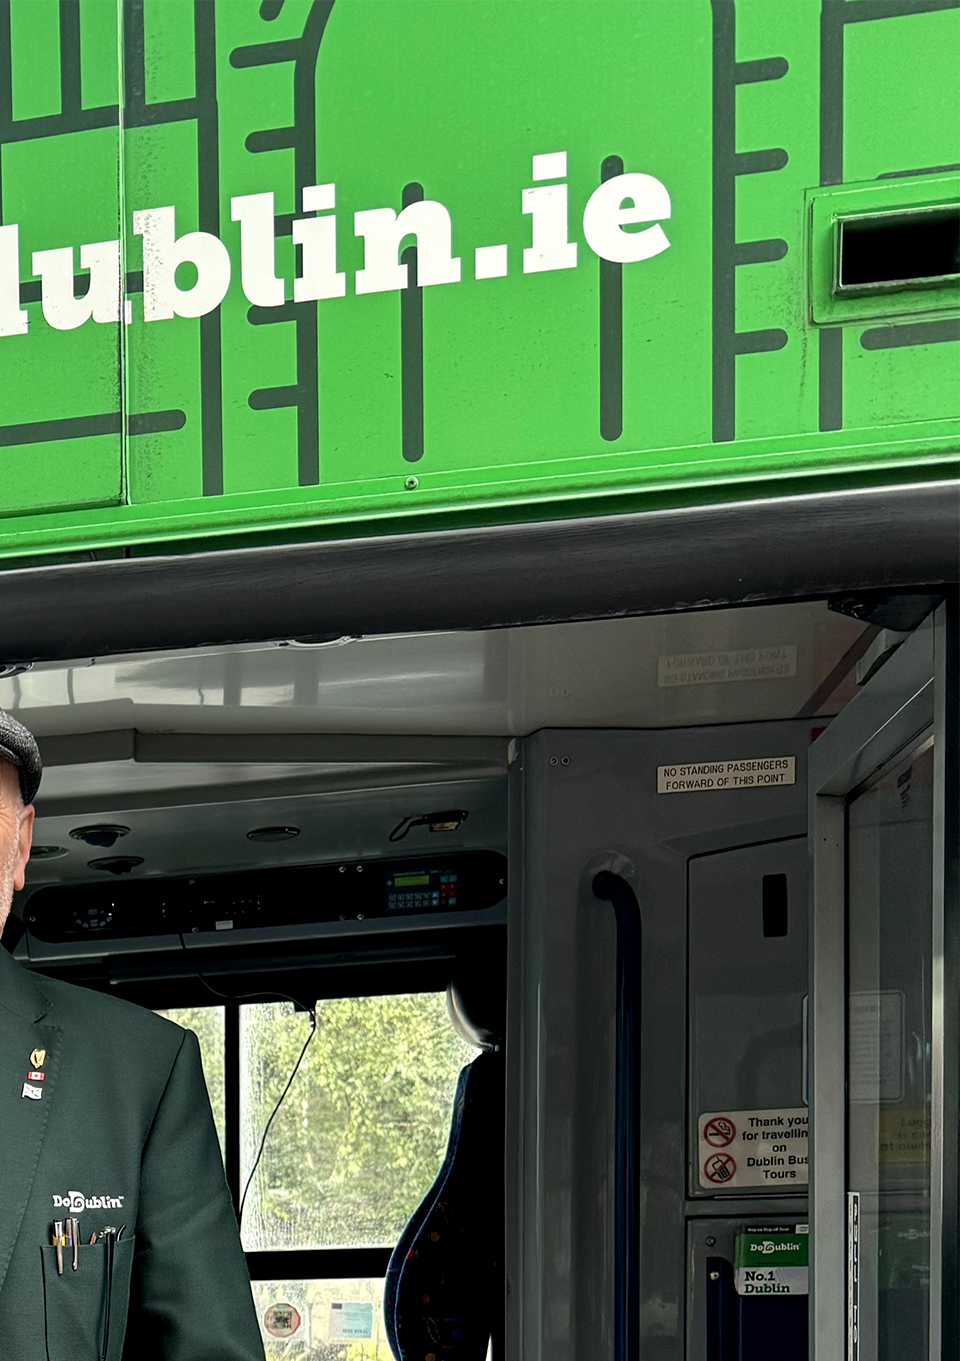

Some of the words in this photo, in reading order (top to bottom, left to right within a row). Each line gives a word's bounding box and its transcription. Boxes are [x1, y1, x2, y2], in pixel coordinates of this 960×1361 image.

[664, 767, 677, 777] NO
[680, 764, 724, 776] STANDING
[727, 759, 789, 773] PASSENGERS
[666, 778, 714, 791] FORWARD
[717, 777, 729, 787] OF
[734, 775, 754, 786] THIS
[757, 773, 786, 784] POINT
[748, 1116, 784, 1128] Thank
[787, 1117, 809, 1129] you
[742, 1131, 759, 1141] for
[762, 1128, 809, 1140] travellin
[772, 1143, 787, 1152] on
[747, 1155, 785, 1167] Dublin
[762, 1169, 796, 1179] Tours
[745, 1271, 775, 1282] No.1
[745, 1283, 790, 1294] Dublin
